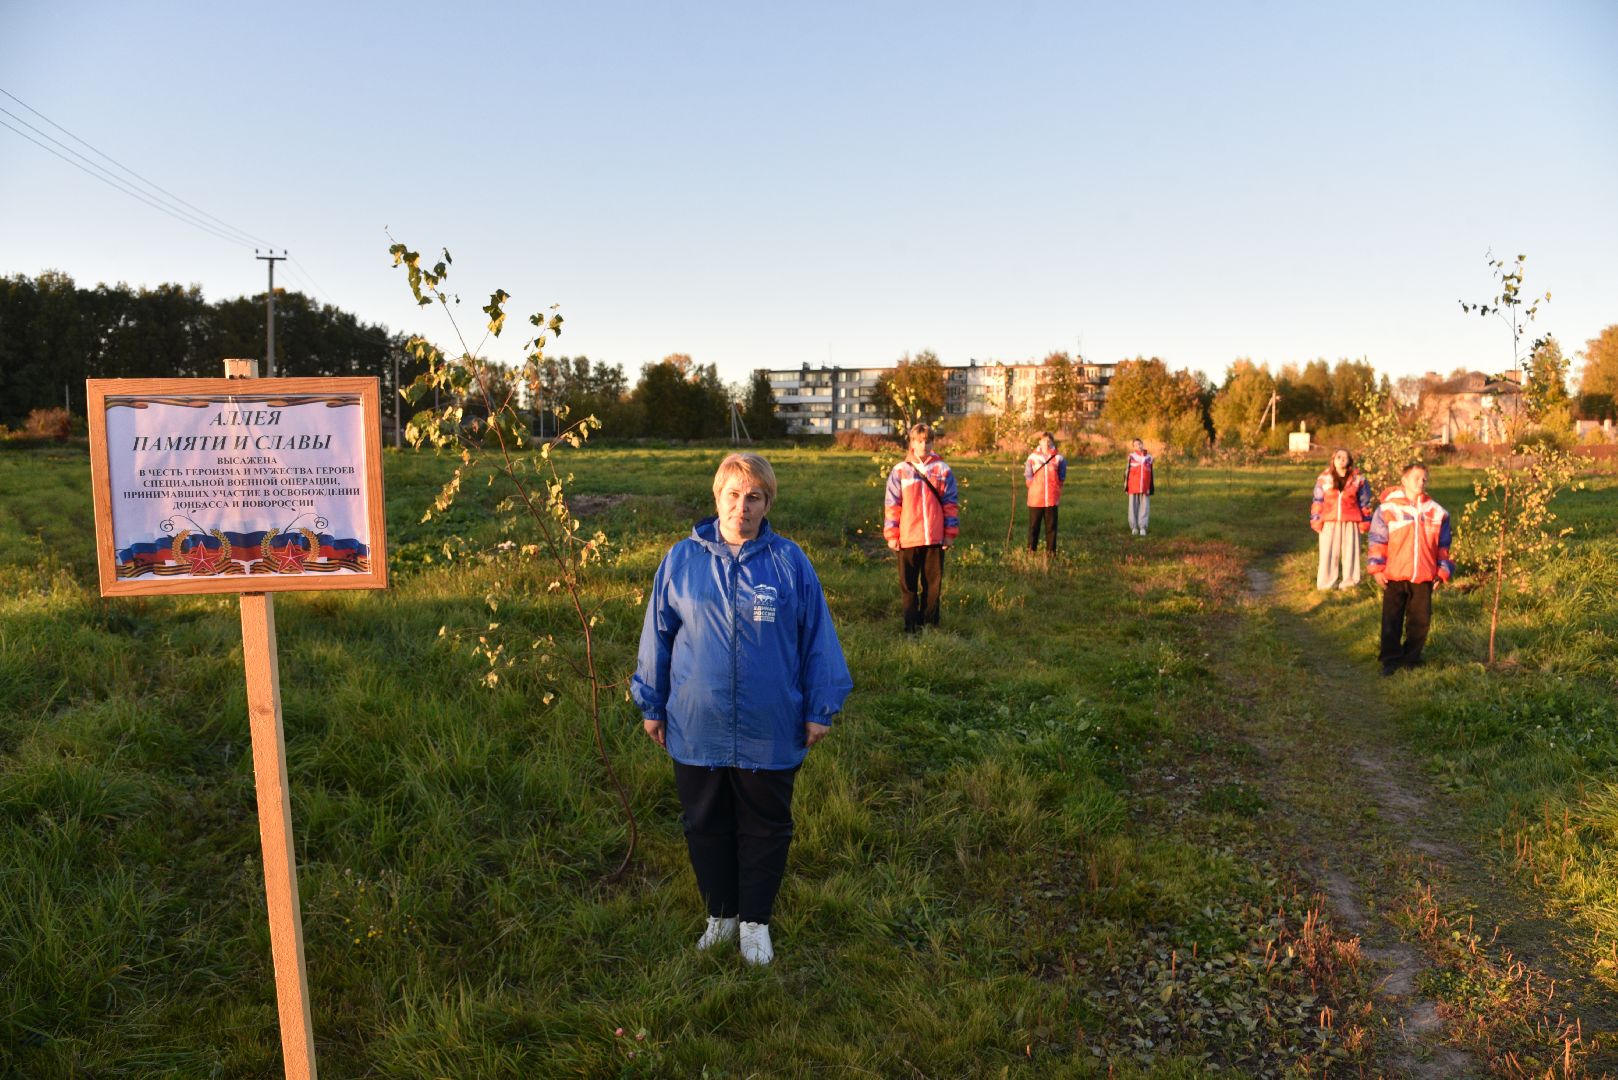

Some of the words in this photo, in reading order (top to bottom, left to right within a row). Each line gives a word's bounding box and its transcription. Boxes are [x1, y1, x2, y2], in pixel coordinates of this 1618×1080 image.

[209, 410, 282, 426] АЛЛЕЯ
[133, 436, 227, 451] ПАМЯТИ
[233, 435, 249, 450] И
[255, 434, 332, 450] СЛАВЫ
[217, 456, 277, 465] ВЫСАЖЕНА
[139, 469, 146, 477] В
[148, 468, 183, 477] ЧЕСТЬ
[186, 468, 240, 476] ГЕРОИЗМА
[244, 467, 251, 476] И
[254, 467, 313, 475] МУЖЕСТВА
[316, 466, 355, 474] ГЕРОЕВ
[143, 477, 224, 488] СПЕЦИАЛЬНОЙ
[227, 476, 278, 486] ВОЕННОЙ
[280, 477, 341, 486] ОПЕРАЦИИ,
[123, 490, 209, 499] ПРИНИМАВШИХ
[213, 489, 261, 498] УЧАСТИЕ
[263, 489, 270, 497] В
[272, 488, 361, 497] ОСВОБОЖДЕНИИ
[172, 500, 230, 510] ДОНБАССА
[232, 500, 239, 508] И
[242, 499, 314, 508] НОВОРОССИИ
